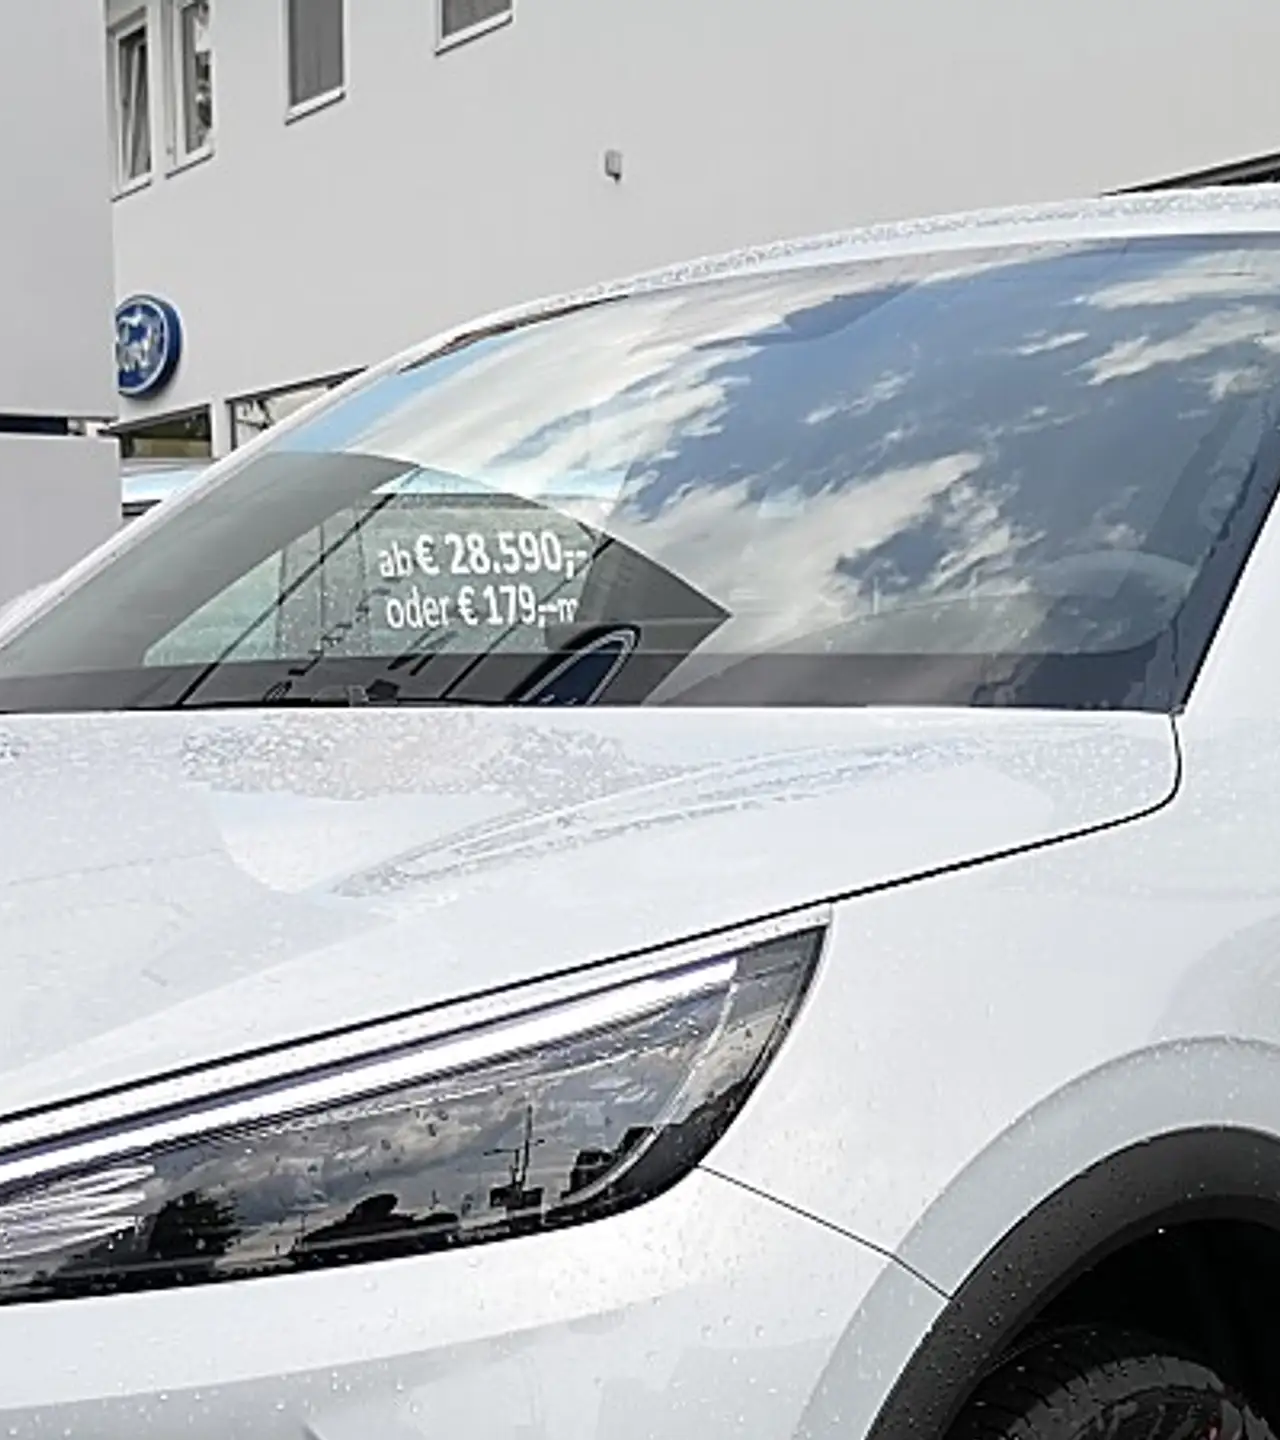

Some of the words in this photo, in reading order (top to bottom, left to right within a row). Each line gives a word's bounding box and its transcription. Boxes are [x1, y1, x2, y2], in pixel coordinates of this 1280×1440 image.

[379, 541, 412, 577] ab
[416, 534, 439, 576] €
[386, 588, 449, 628] oder
[458, 586, 478, 625] €
